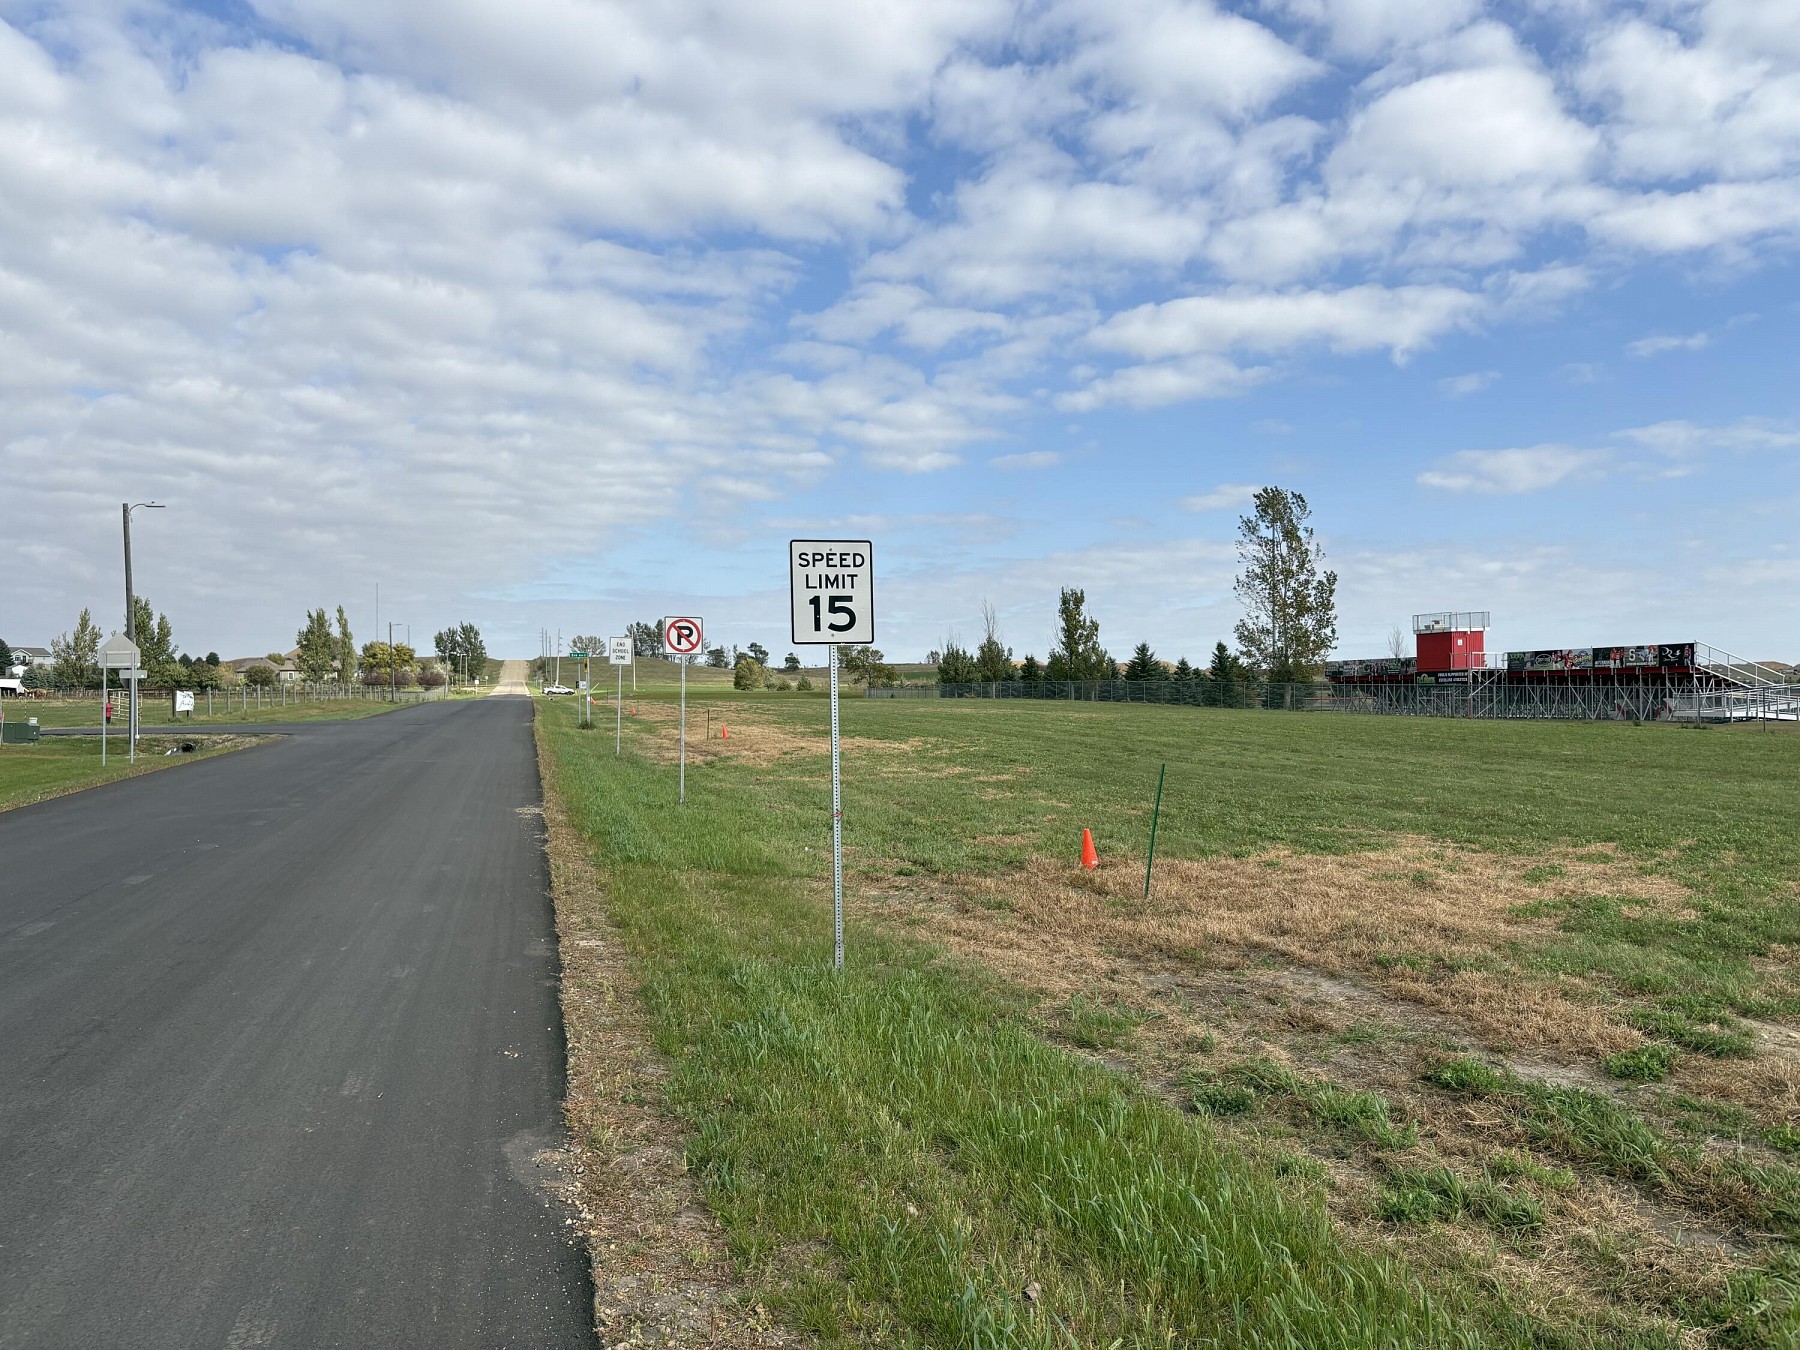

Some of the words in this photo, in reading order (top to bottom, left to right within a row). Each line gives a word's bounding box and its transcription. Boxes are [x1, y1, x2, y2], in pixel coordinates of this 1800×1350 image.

[798, 552, 865, 568] SPEED
[805, 573, 858, 589] LIMIT
[808, 595, 857, 632] 15
